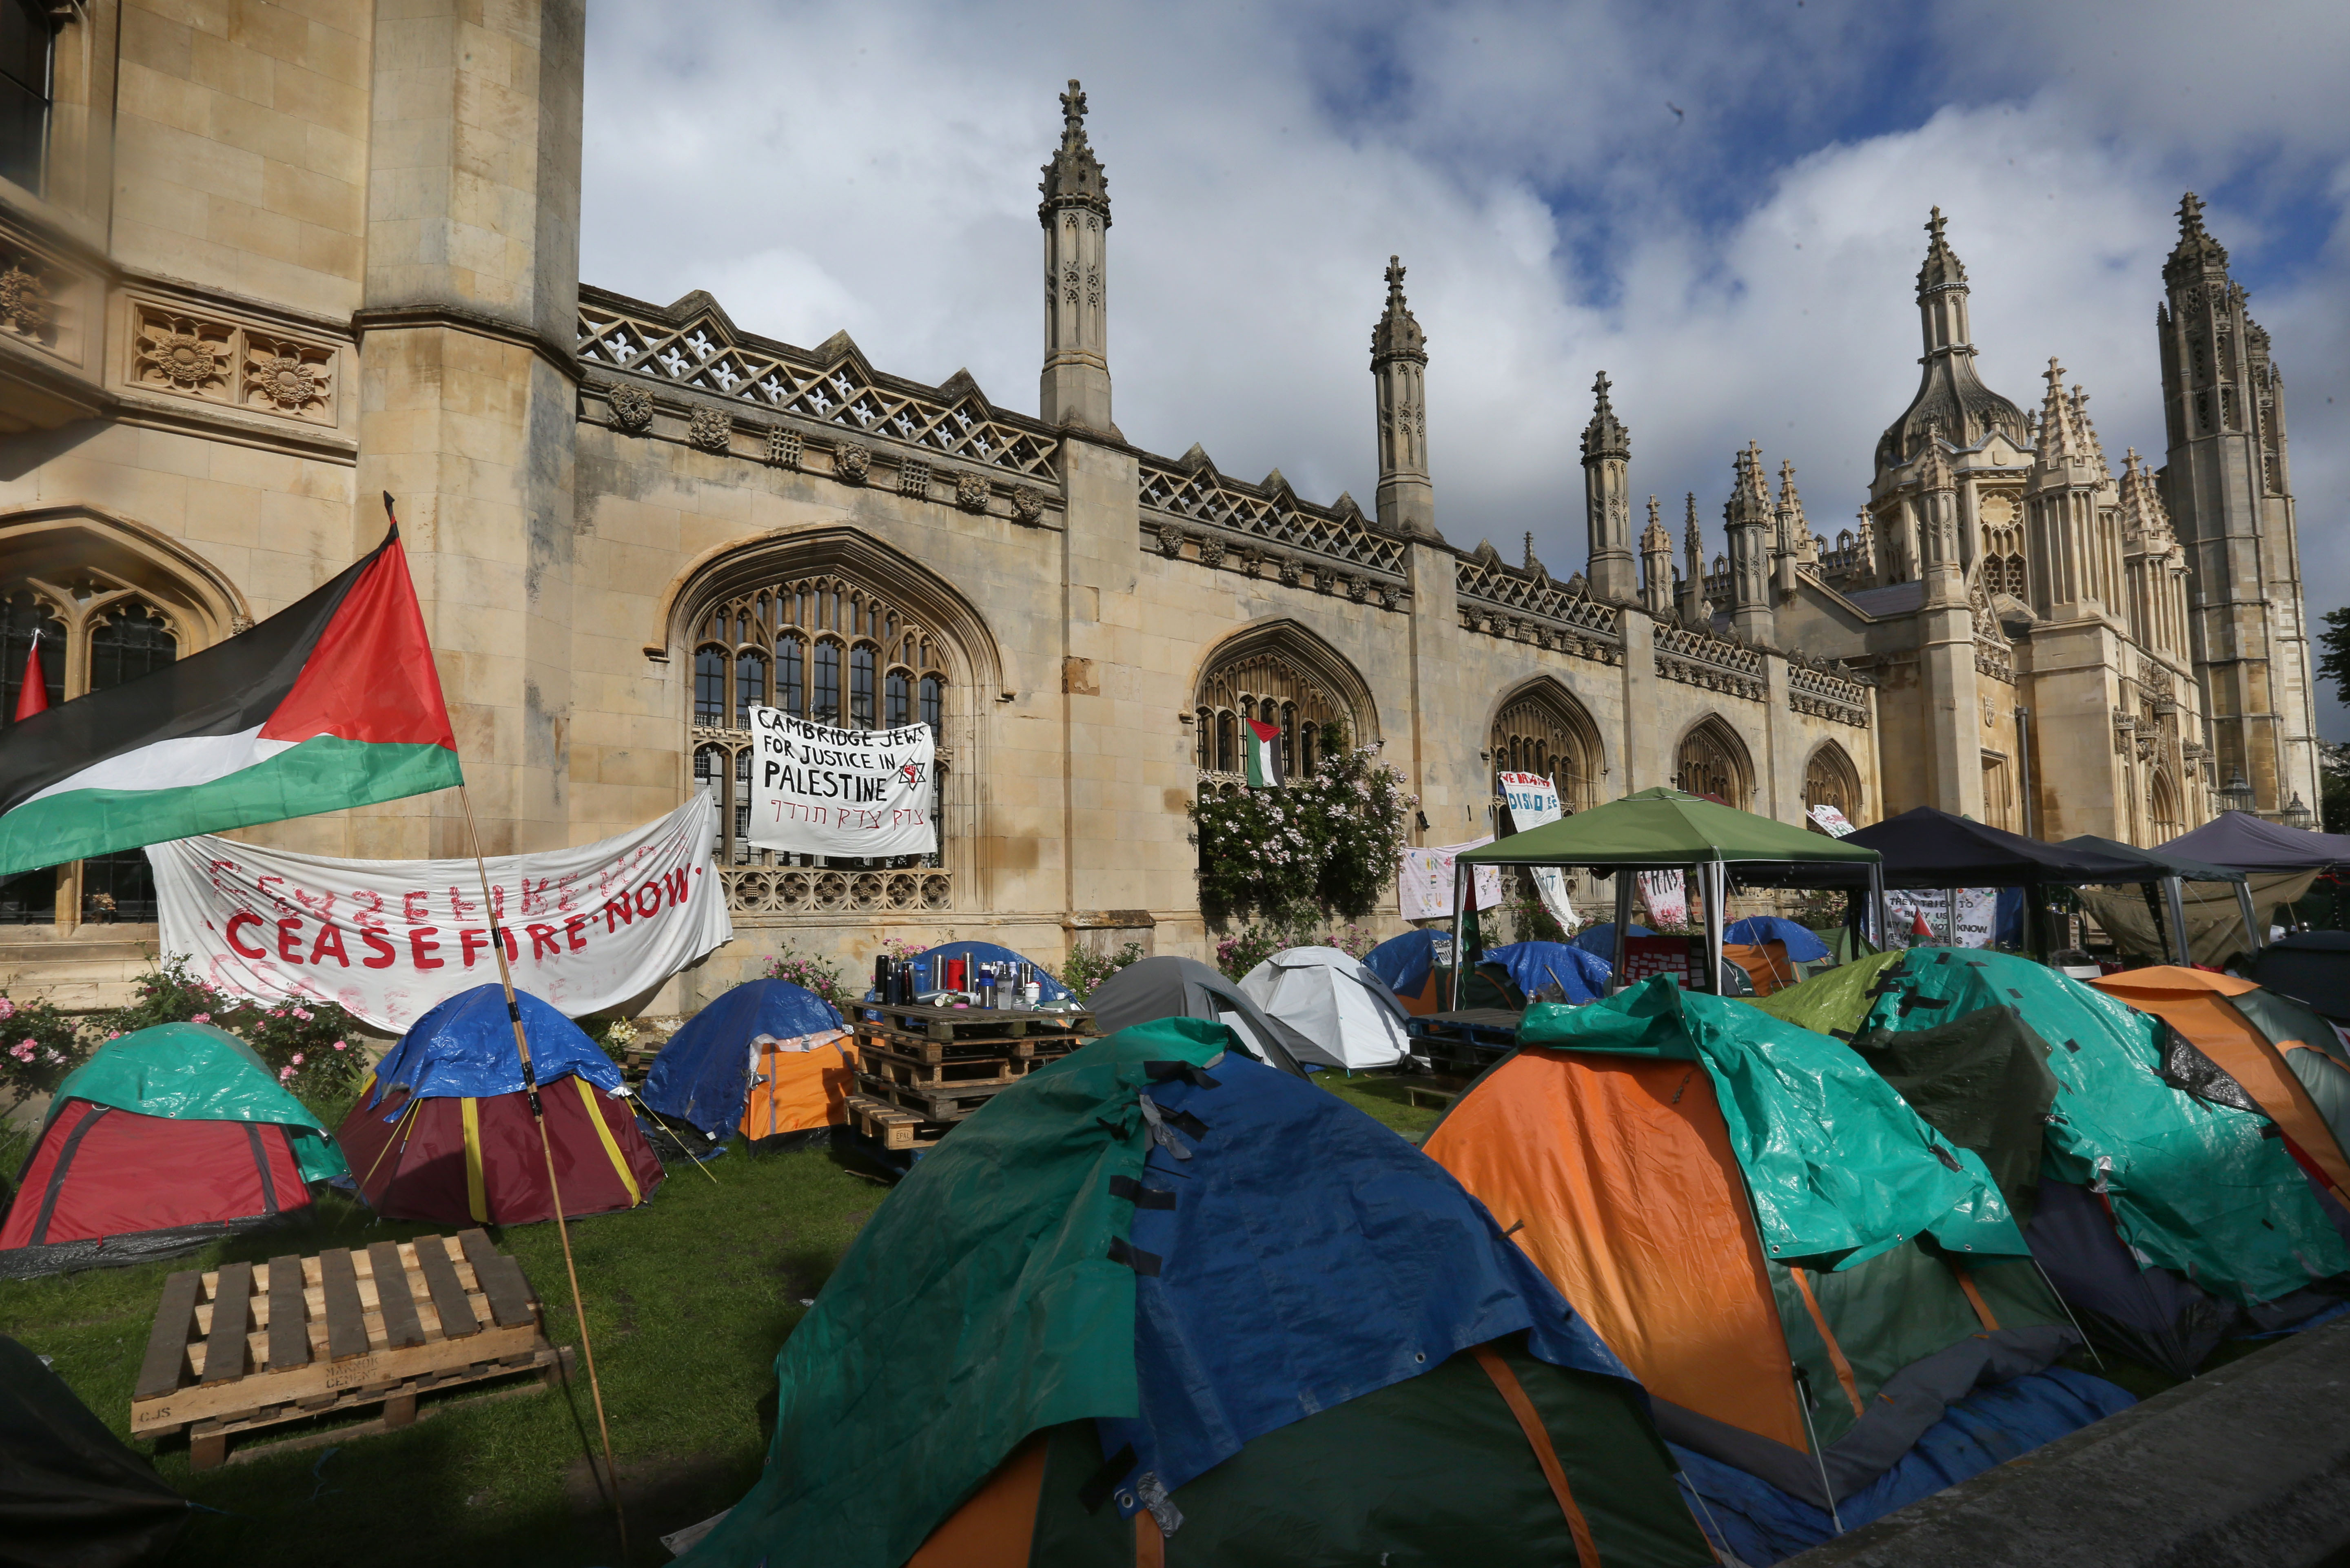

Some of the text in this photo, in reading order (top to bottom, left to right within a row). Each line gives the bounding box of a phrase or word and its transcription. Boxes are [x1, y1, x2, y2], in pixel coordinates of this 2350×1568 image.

[757, 709, 925, 748] CAMBRIDGE JEWS
[764, 735, 896, 770] FOR JUSTICE IN
[764, 760, 887, 802] PALESTINE
[836, 806, 882, 830] צדק
[892, 808, 924, 831] צדק
[1904, 910, 1930, 919] BUY
[1921, 900, 1948, 908] TRIE
[1959, 900, 1973, 908] TO
[1931, 936, 1963, 944] SEES
[1956, 924, 1988, 934] KNOW
[226, 912, 588, 969] CEASEFIRE
[326, 1368, 377, 1389] CEMENT
[140, 1407, 171, 1422] CJS
